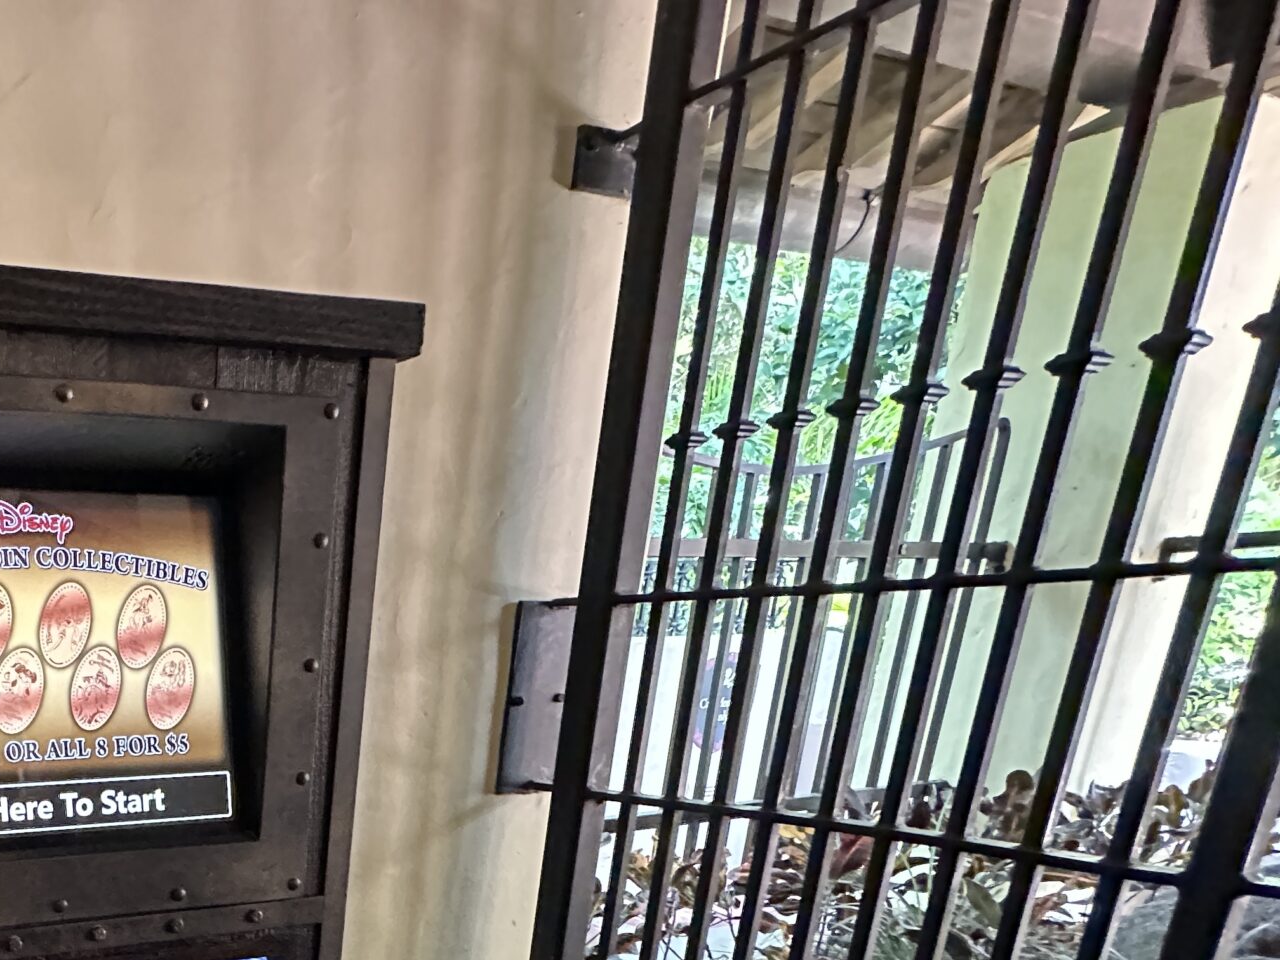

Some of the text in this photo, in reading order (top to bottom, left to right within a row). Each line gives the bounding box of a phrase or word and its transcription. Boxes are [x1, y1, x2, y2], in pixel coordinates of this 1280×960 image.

[35, 547, 209, 590] COLLECTIBLES
[5, 740, 42, 763] OR
[45, 737, 91, 760] ALL
[96, 737, 108, 758] 8
[112, 734, 162, 757] FOR
[165, 732, 189, 755] $5
[58, 791, 93, 818] To
[100, 788, 166, 815] Start
